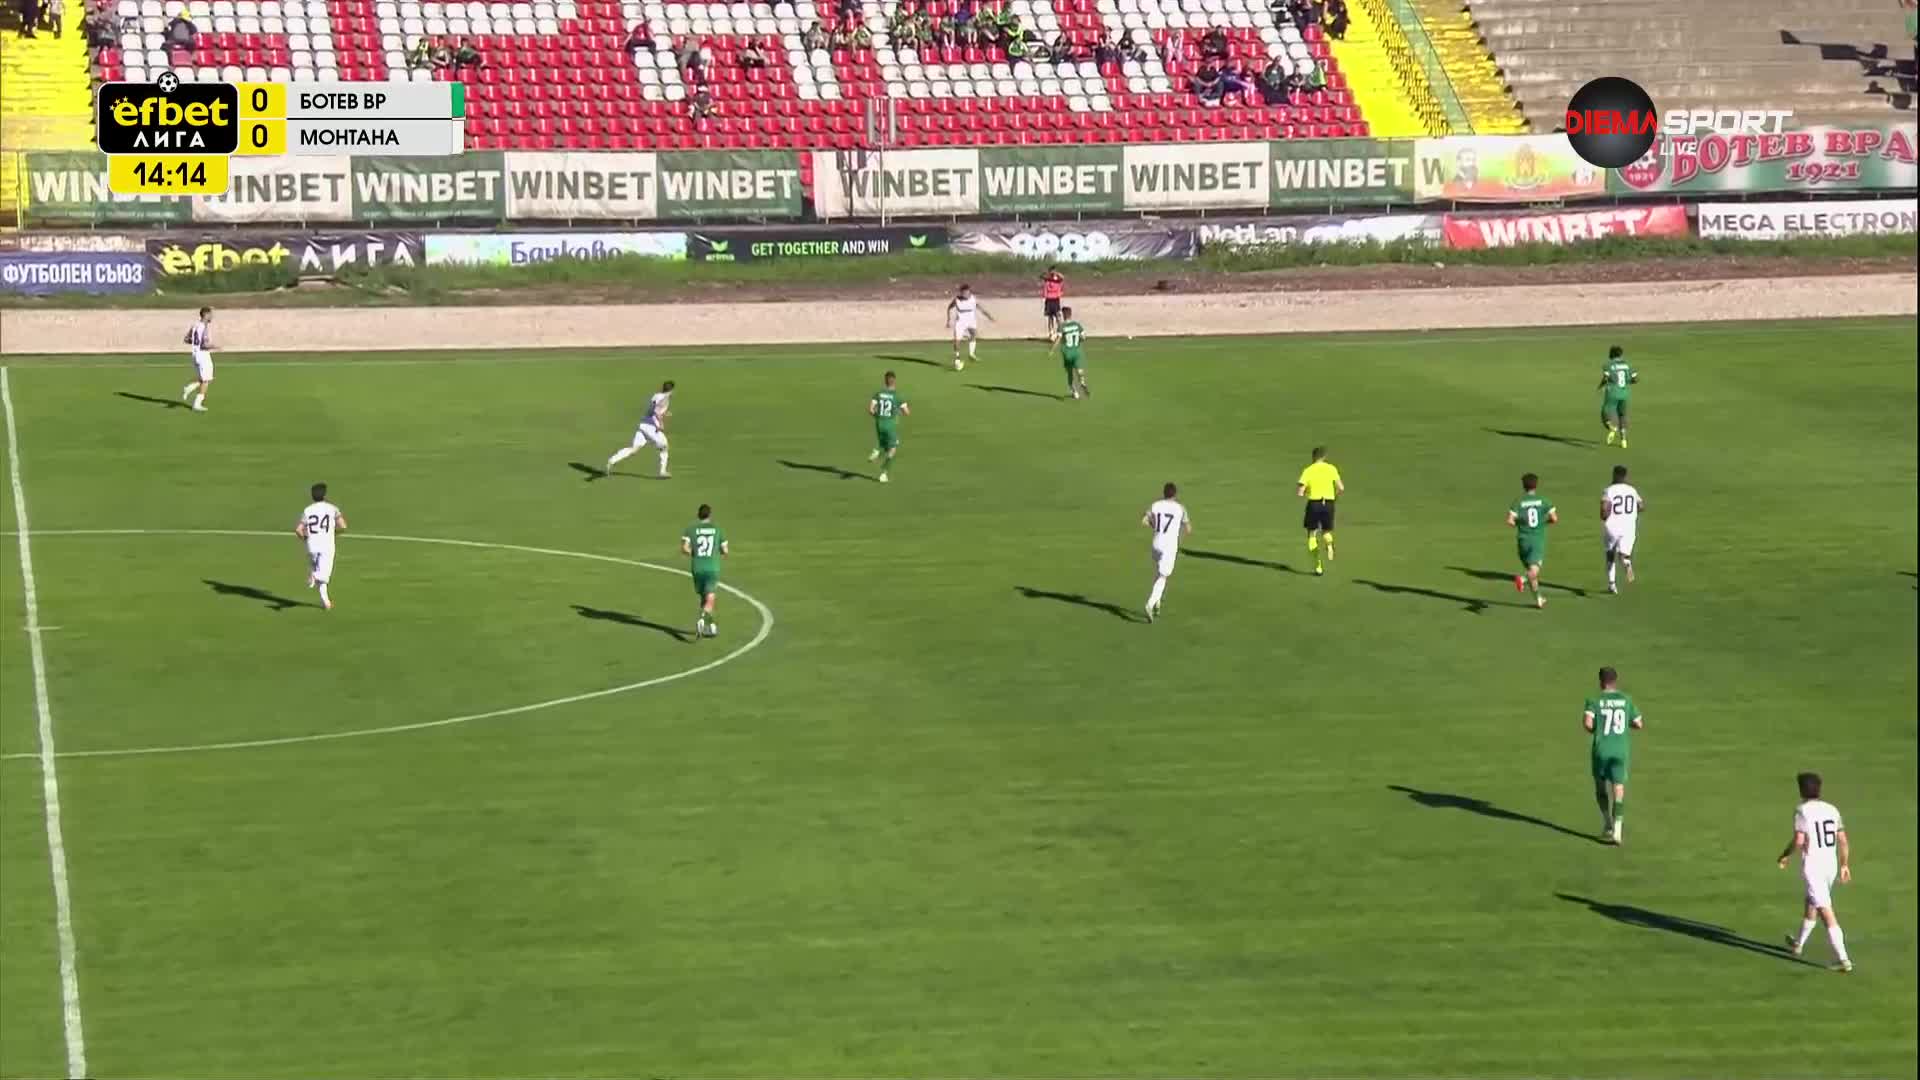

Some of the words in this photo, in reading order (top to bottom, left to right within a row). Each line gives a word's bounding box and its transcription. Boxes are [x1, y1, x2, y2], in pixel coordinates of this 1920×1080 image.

[1671, 130, 1816, 187] БОТЕВ
[1824, 129, 1918, 165] ВРА
[1785, 159, 1862, 185] 1921
[204, 171, 345, 203] INBET
[355, 169, 499, 203] WINBET
[511, 169, 652, 201] WINBET
[661, 168, 798, 201] WINBET
[840, 166, 974, 198] WINBET
[984, 163, 1119, 197] WINBET
[1130, 160, 1263, 193] WINBET
[1274, 157, 1409, 190] WINBET
[1701, 214, 1775, 232] MEGA
[751, 242, 775, 257] GET
[778, 240, 839, 256] TOGETHER
[842, 239, 866, 254] AND
[868, 238, 889, 253] WIN
[3, 262, 92, 284] ФУТБОЛЕН
[95, 263, 144, 284] СЪЮЗ
[879, 399, 893, 417] 12
[1612, 494, 1635, 515] 20
[307, 513, 331, 534] 24
[1156, 512, 1175, 534] 17
[696, 535, 714, 557] 21
[1600, 708, 1626, 736] 79
[1814, 819, 1837, 848] 16
